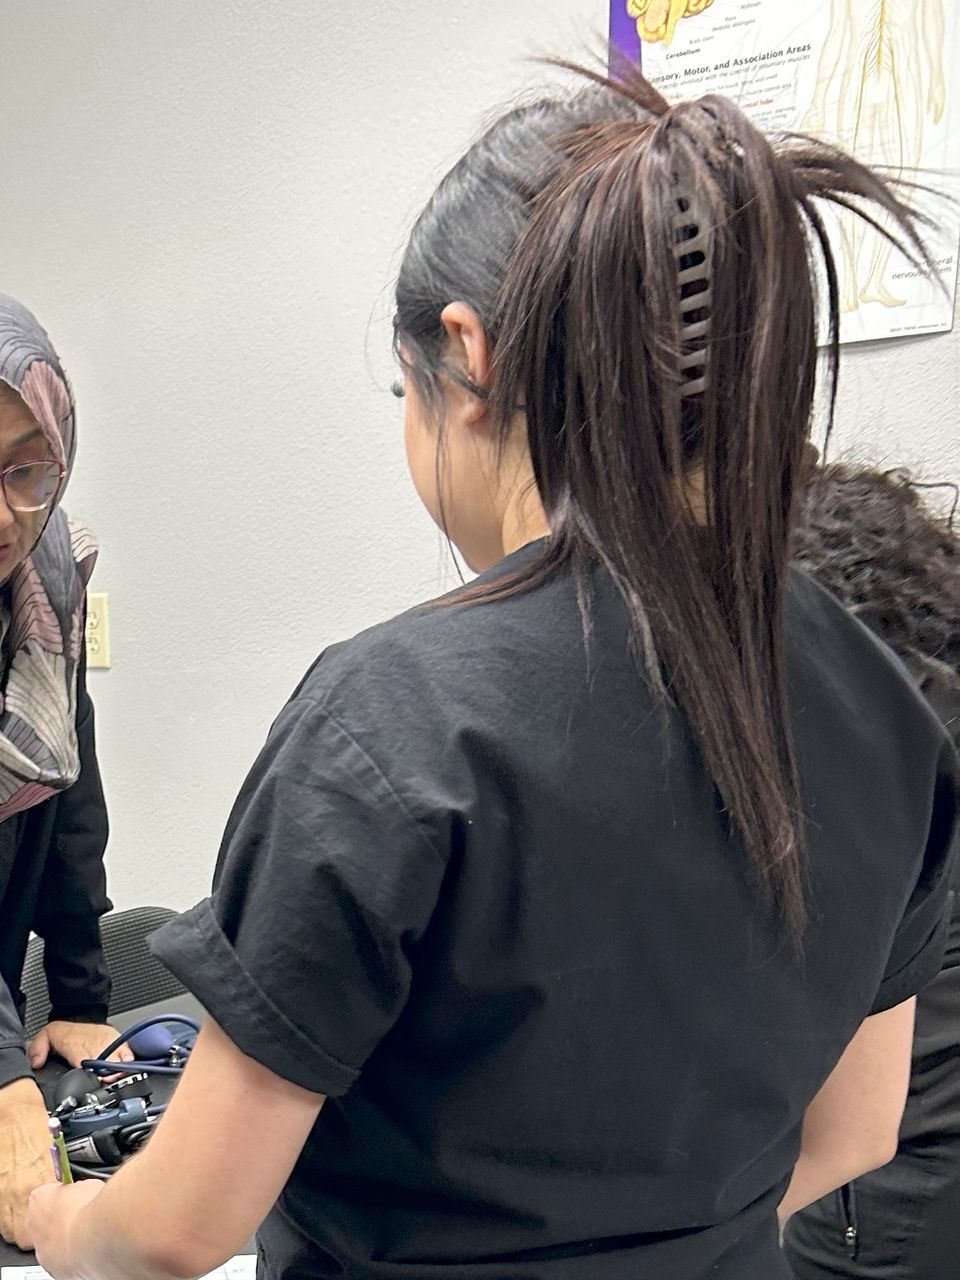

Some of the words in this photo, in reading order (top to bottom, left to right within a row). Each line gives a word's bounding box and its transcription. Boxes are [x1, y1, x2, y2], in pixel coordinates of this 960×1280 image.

[666, 48, 701, 60] Cerebellum
[684, 66, 711, 77] Motor,
[714, 60, 730, 71] and
[733, 50, 784, 67] Association
[786, 43, 812, 55] Areas
